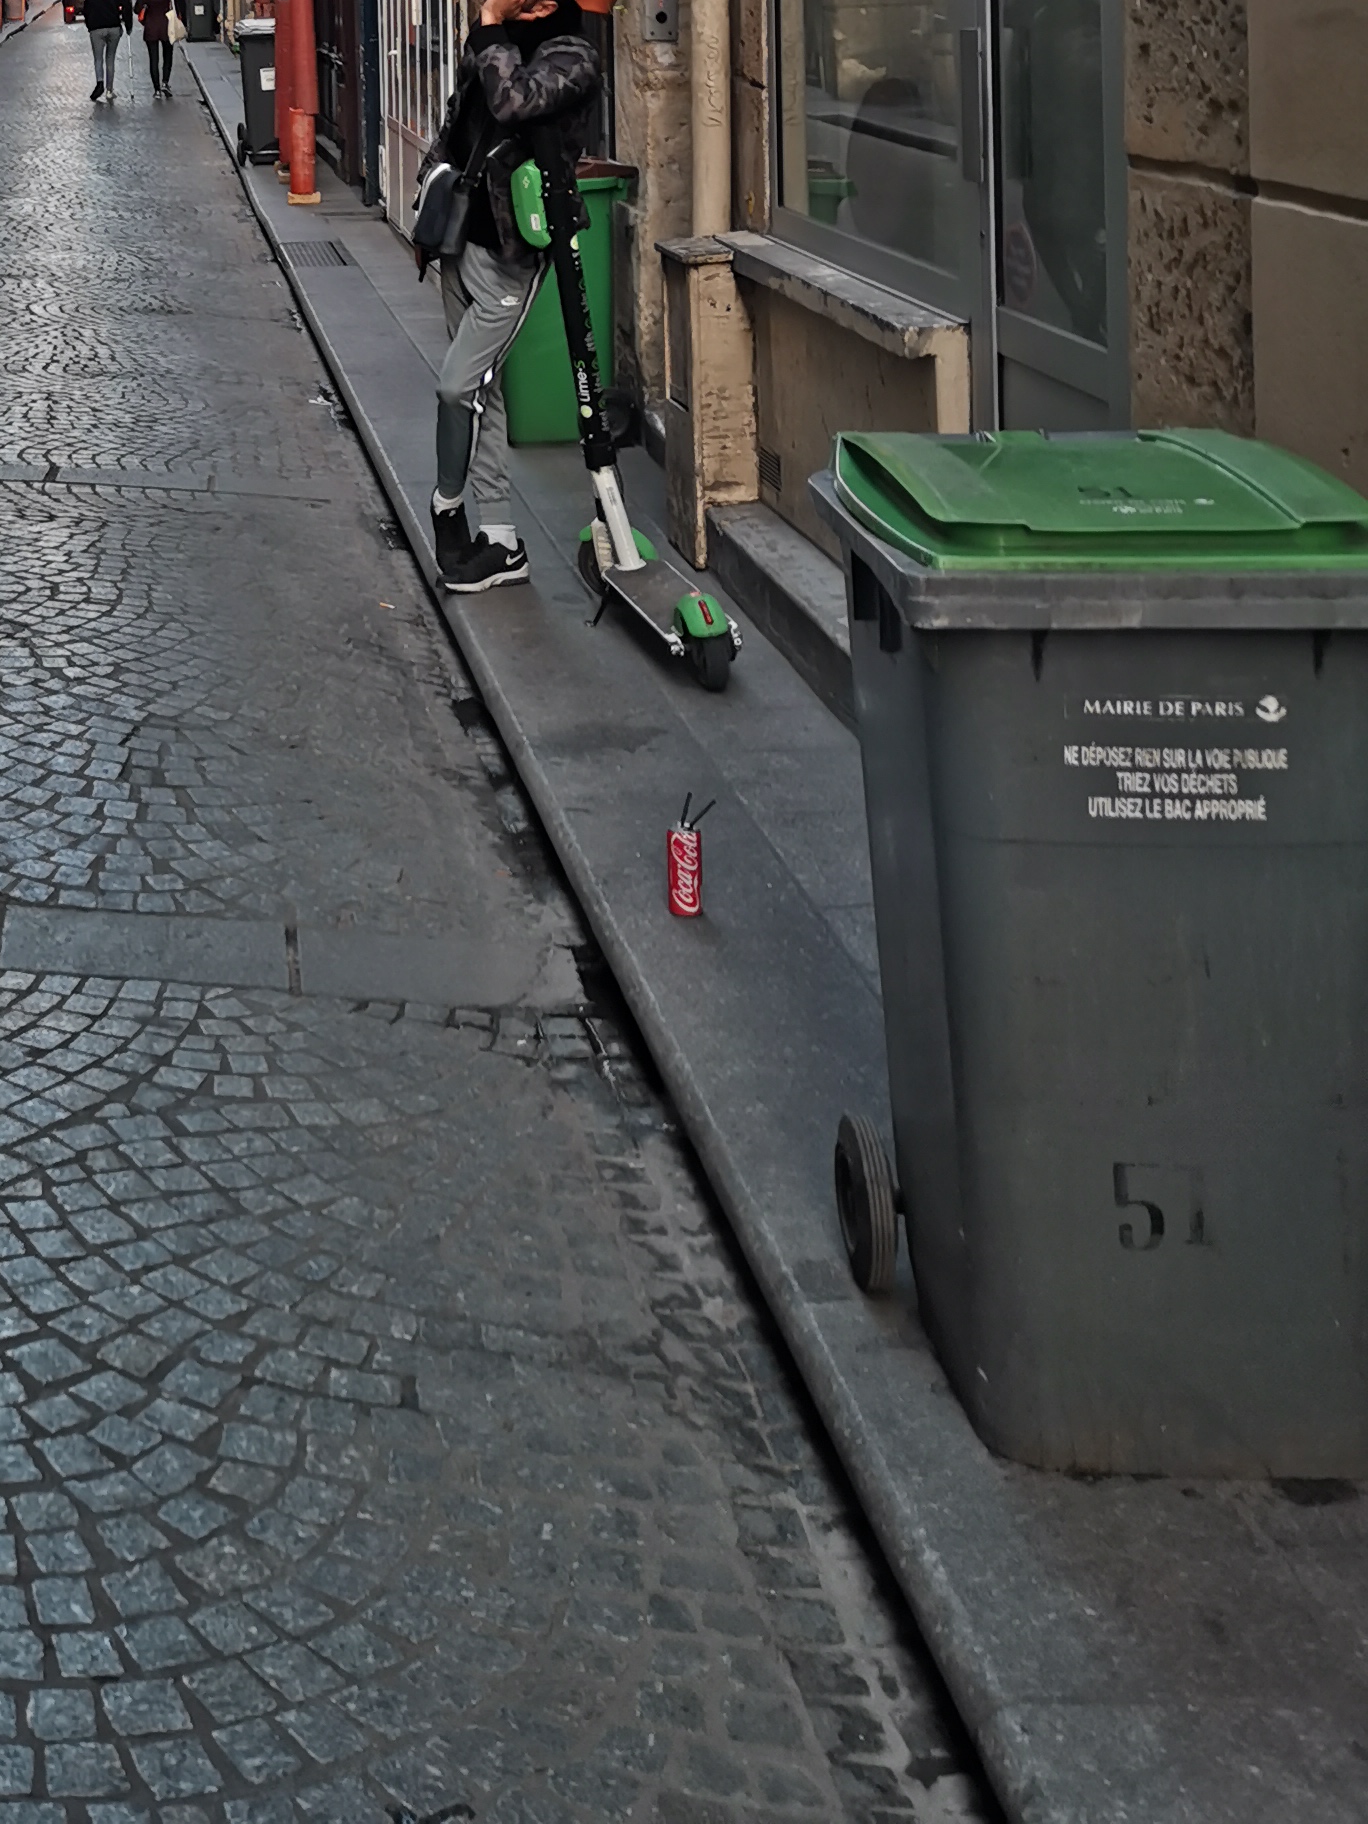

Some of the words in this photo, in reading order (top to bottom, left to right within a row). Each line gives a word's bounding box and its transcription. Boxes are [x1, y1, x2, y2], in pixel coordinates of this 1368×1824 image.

[1084, 699, 1152, 716] MAIRIE
[1159, 701, 1184, 717] DE
[1191, 701, 1245, 717] PARIS
[1064, 745, 1079, 767] NE
[1135, 747, 1161, 768] RIEN
[1162, 748, 1185, 768] SUR
[1188, 748, 1203, 769] LA
[1205, 748, 1231, 769] VOIE
[1233, 748, 1288, 769] PUBLIQUE
[1116, 771, 1151, 793] TRIEZ
[1153, 773, 1179, 794] VOS
[1088, 796, 1143, 819] UTILISEZ
[1145, 798, 1162, 819] LE
[1165, 799, 1191, 819] BAC
[1113, 1162, 1212, 1251] 51
